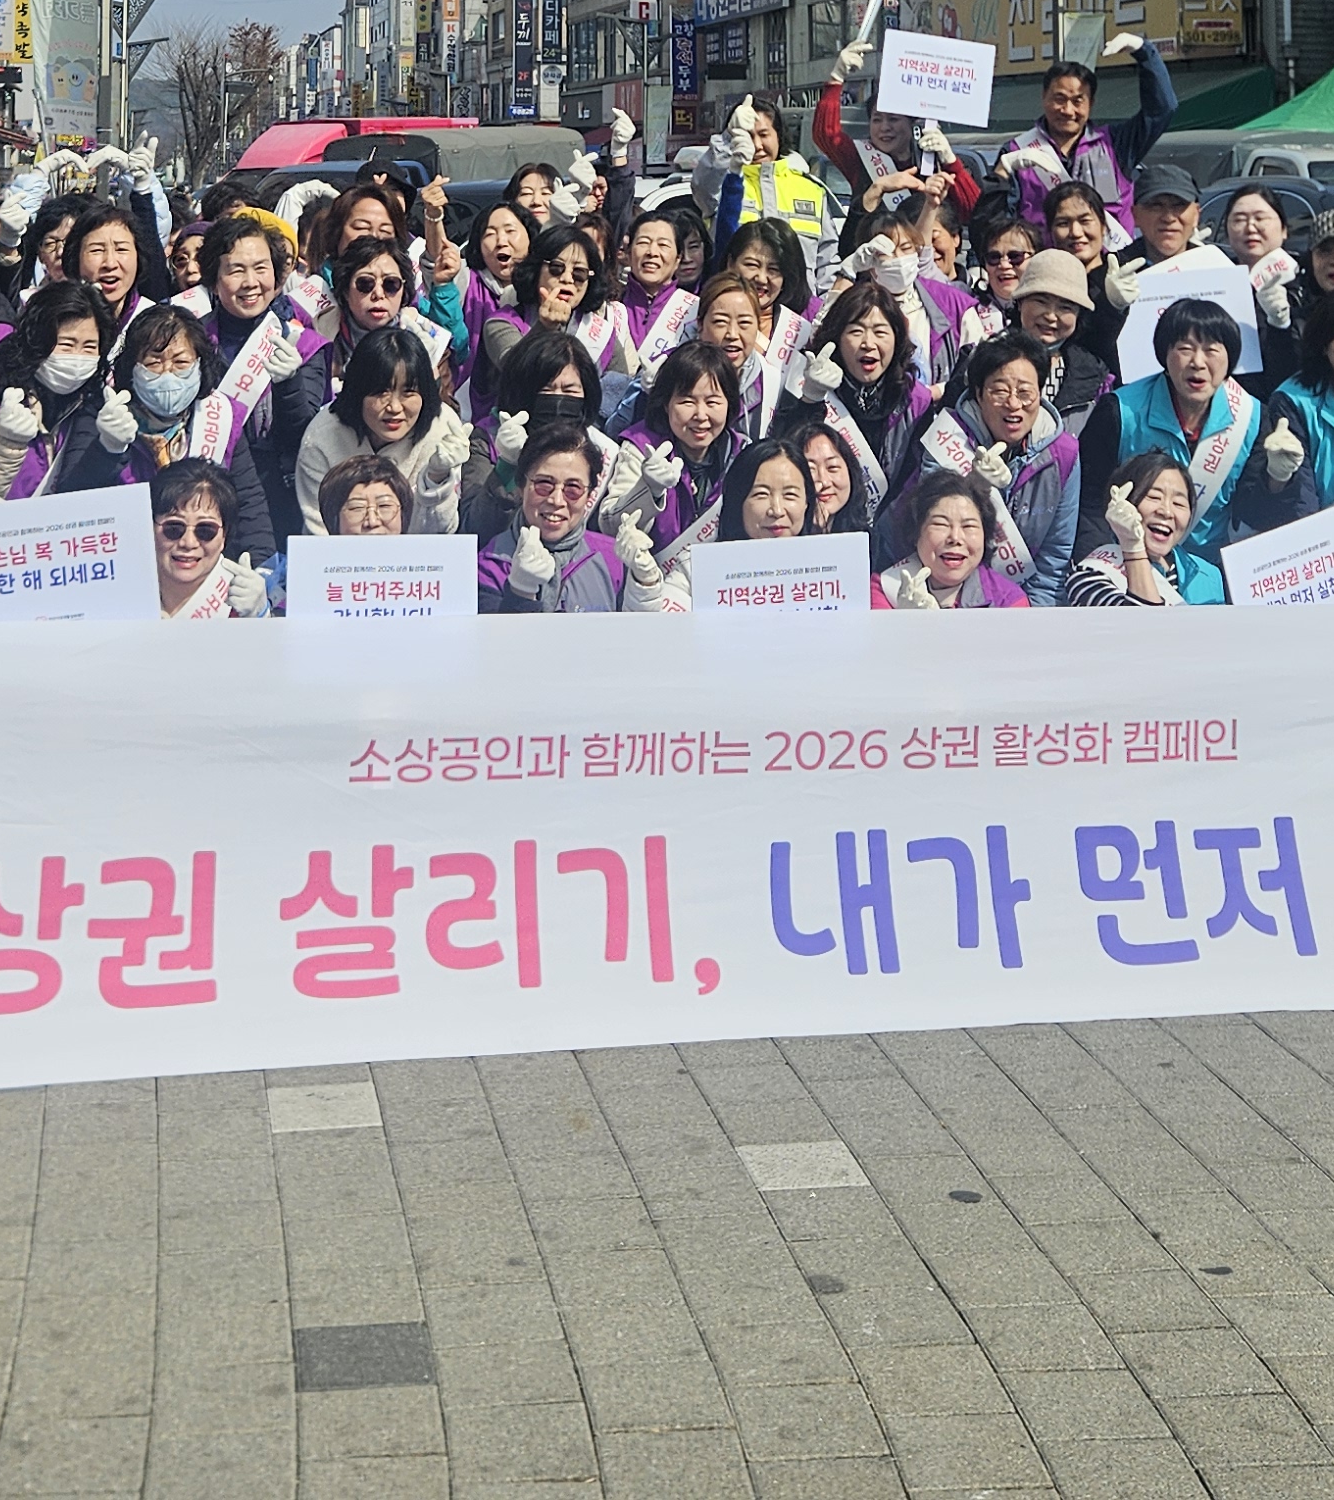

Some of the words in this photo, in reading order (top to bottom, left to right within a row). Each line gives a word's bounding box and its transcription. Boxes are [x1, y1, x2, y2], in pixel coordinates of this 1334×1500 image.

[517, 13, 530, 40] 두끼
[898, 58, 940, 75] 지역상권
[901, 74, 923, 87] 내가
[927, 77, 947, 90] 먼저
[45, 524, 64, 532] 2026
[35, 541, 53, 561] 복
[59, 532, 119, 557] 가득한
[22, 569, 42, 590] 해
[49, 559, 115, 586] 되세요!
[1250, 567, 1300, 598] 지역상권
[326, 582, 343, 602] 늘
[351, 580, 440, 601] 반겨주셔서
[717, 584, 784, 607] 지역상권
[791, 580, 846, 601] 살리기,
[353, 737, 568, 782] 소상공인과
[585, 733, 746, 776] 함께하는
[766, 731, 886, 770] 2026
[904, 727, 978, 768] 상권
[997, 724, 1111, 765] 활성화
[1126, 721, 1234, 762] 캠페인
[281, 837, 719, 997] 살리기,
[770, 826, 1030, 974] 내가
[1075, 817, 1316, 964] 먼저
